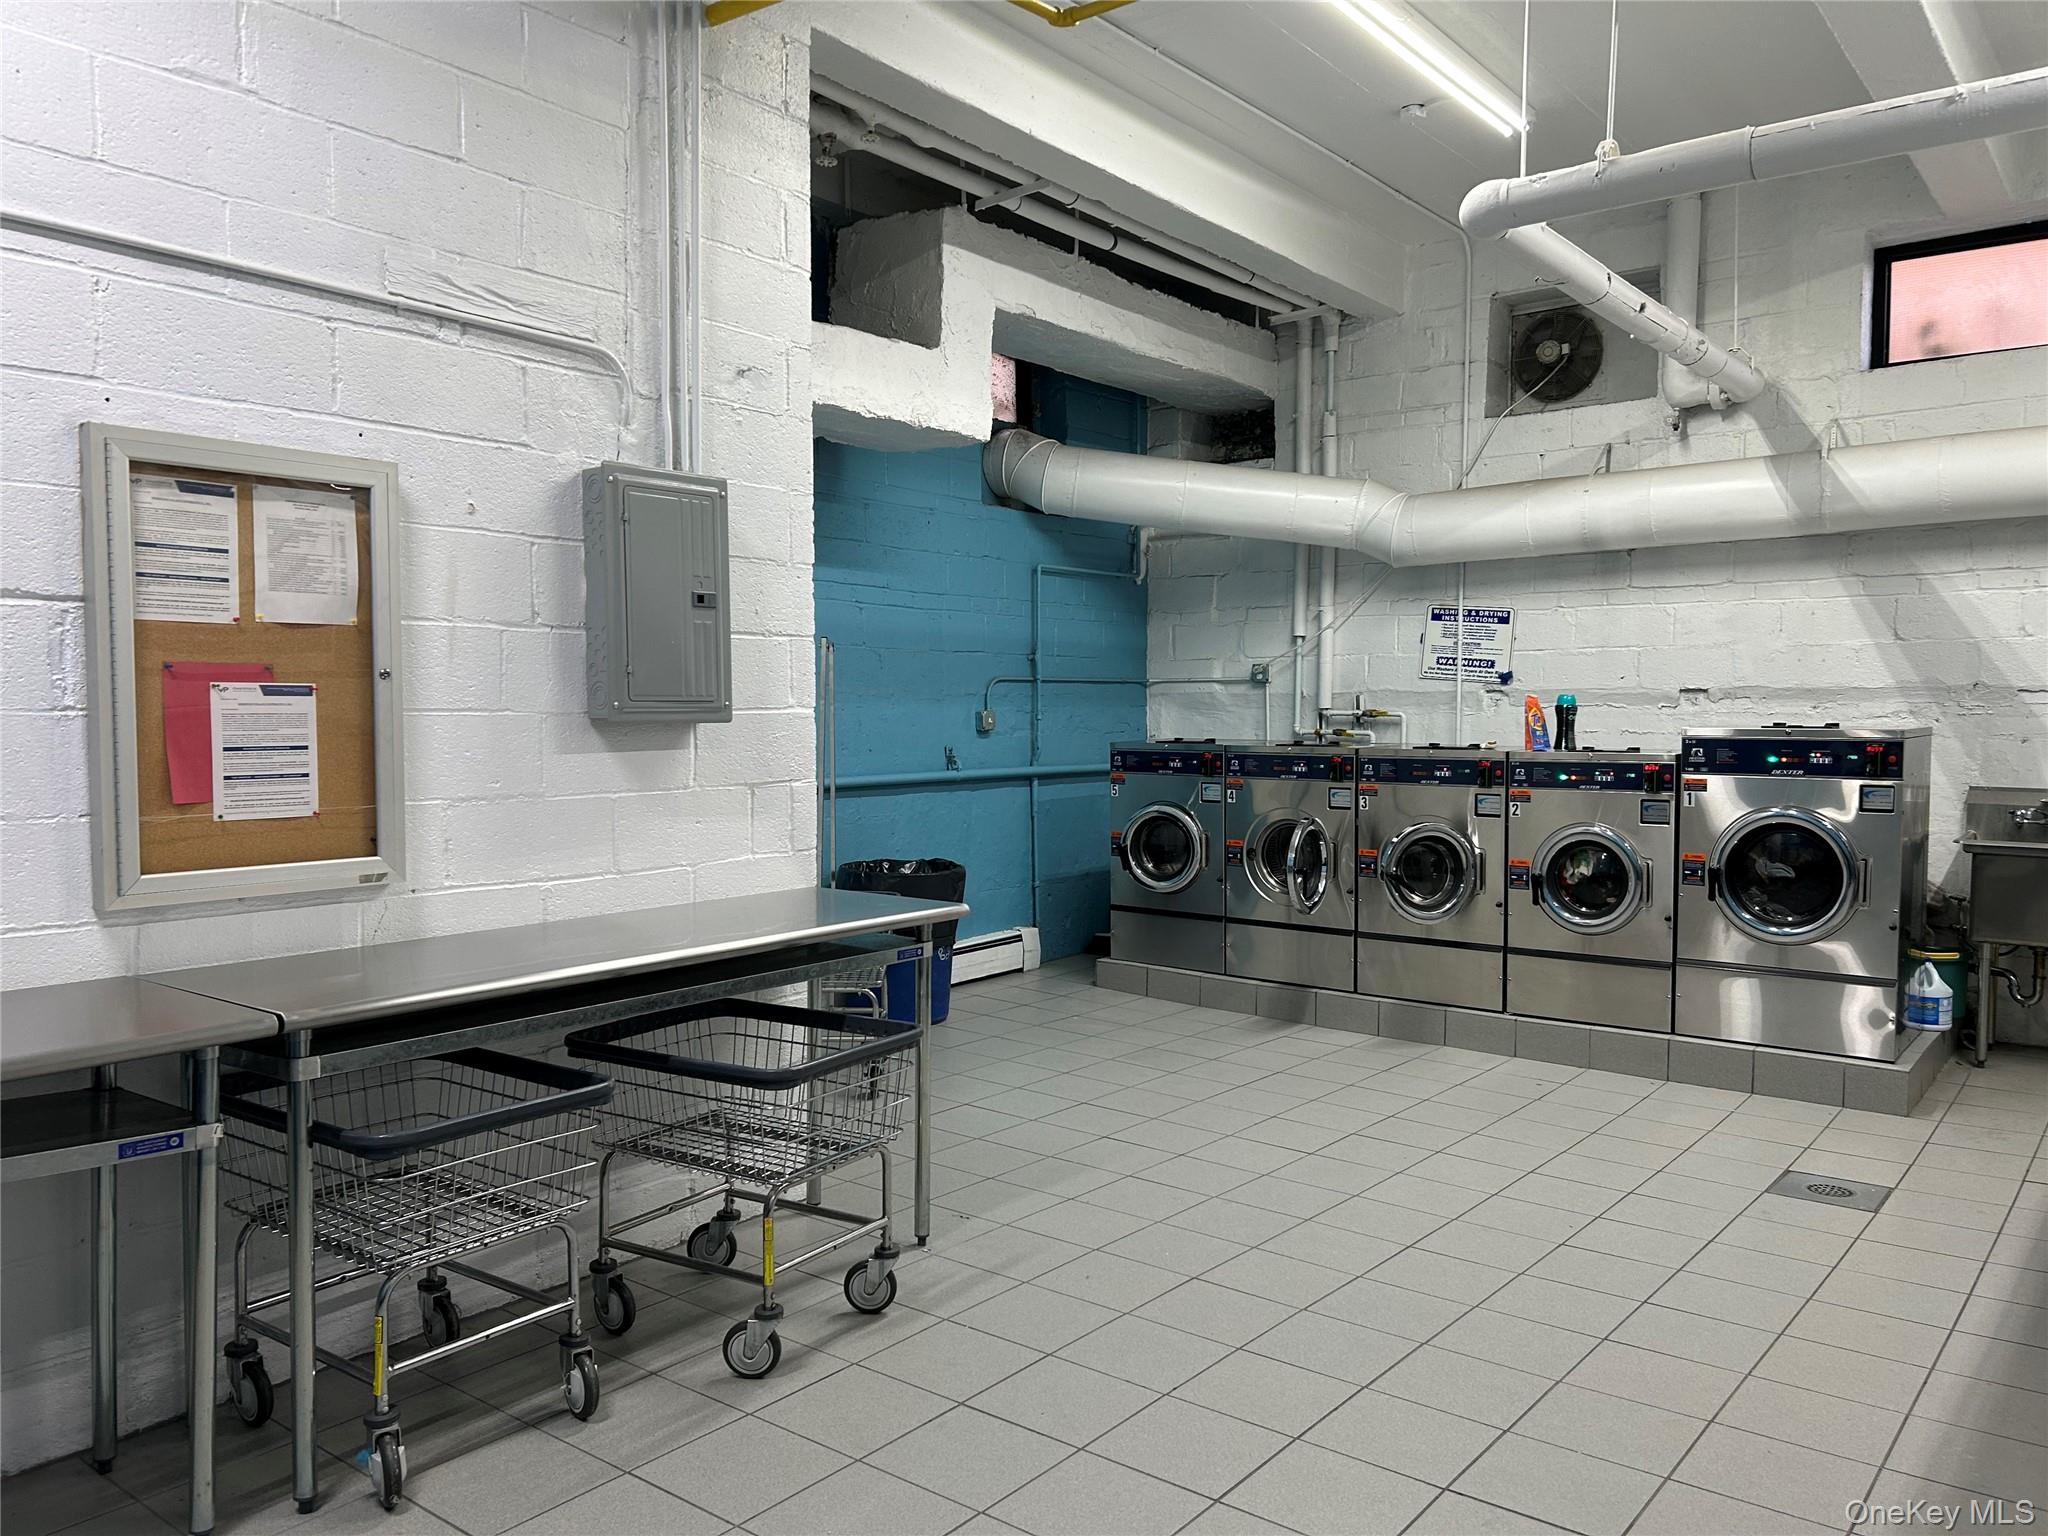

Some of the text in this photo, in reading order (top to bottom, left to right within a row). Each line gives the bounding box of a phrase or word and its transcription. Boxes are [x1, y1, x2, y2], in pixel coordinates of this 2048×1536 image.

[1442, 615, 1498, 623] INSUCTIONS
[1438, 658, 1492, 668] WANING!
[1112, 784, 1118, 796] 5
[1228, 790, 1235, 802] 4
[1361, 797, 1367, 809] 3
[1686, 792, 1692, 806] 1
[1511, 803, 1519, 816] 2
